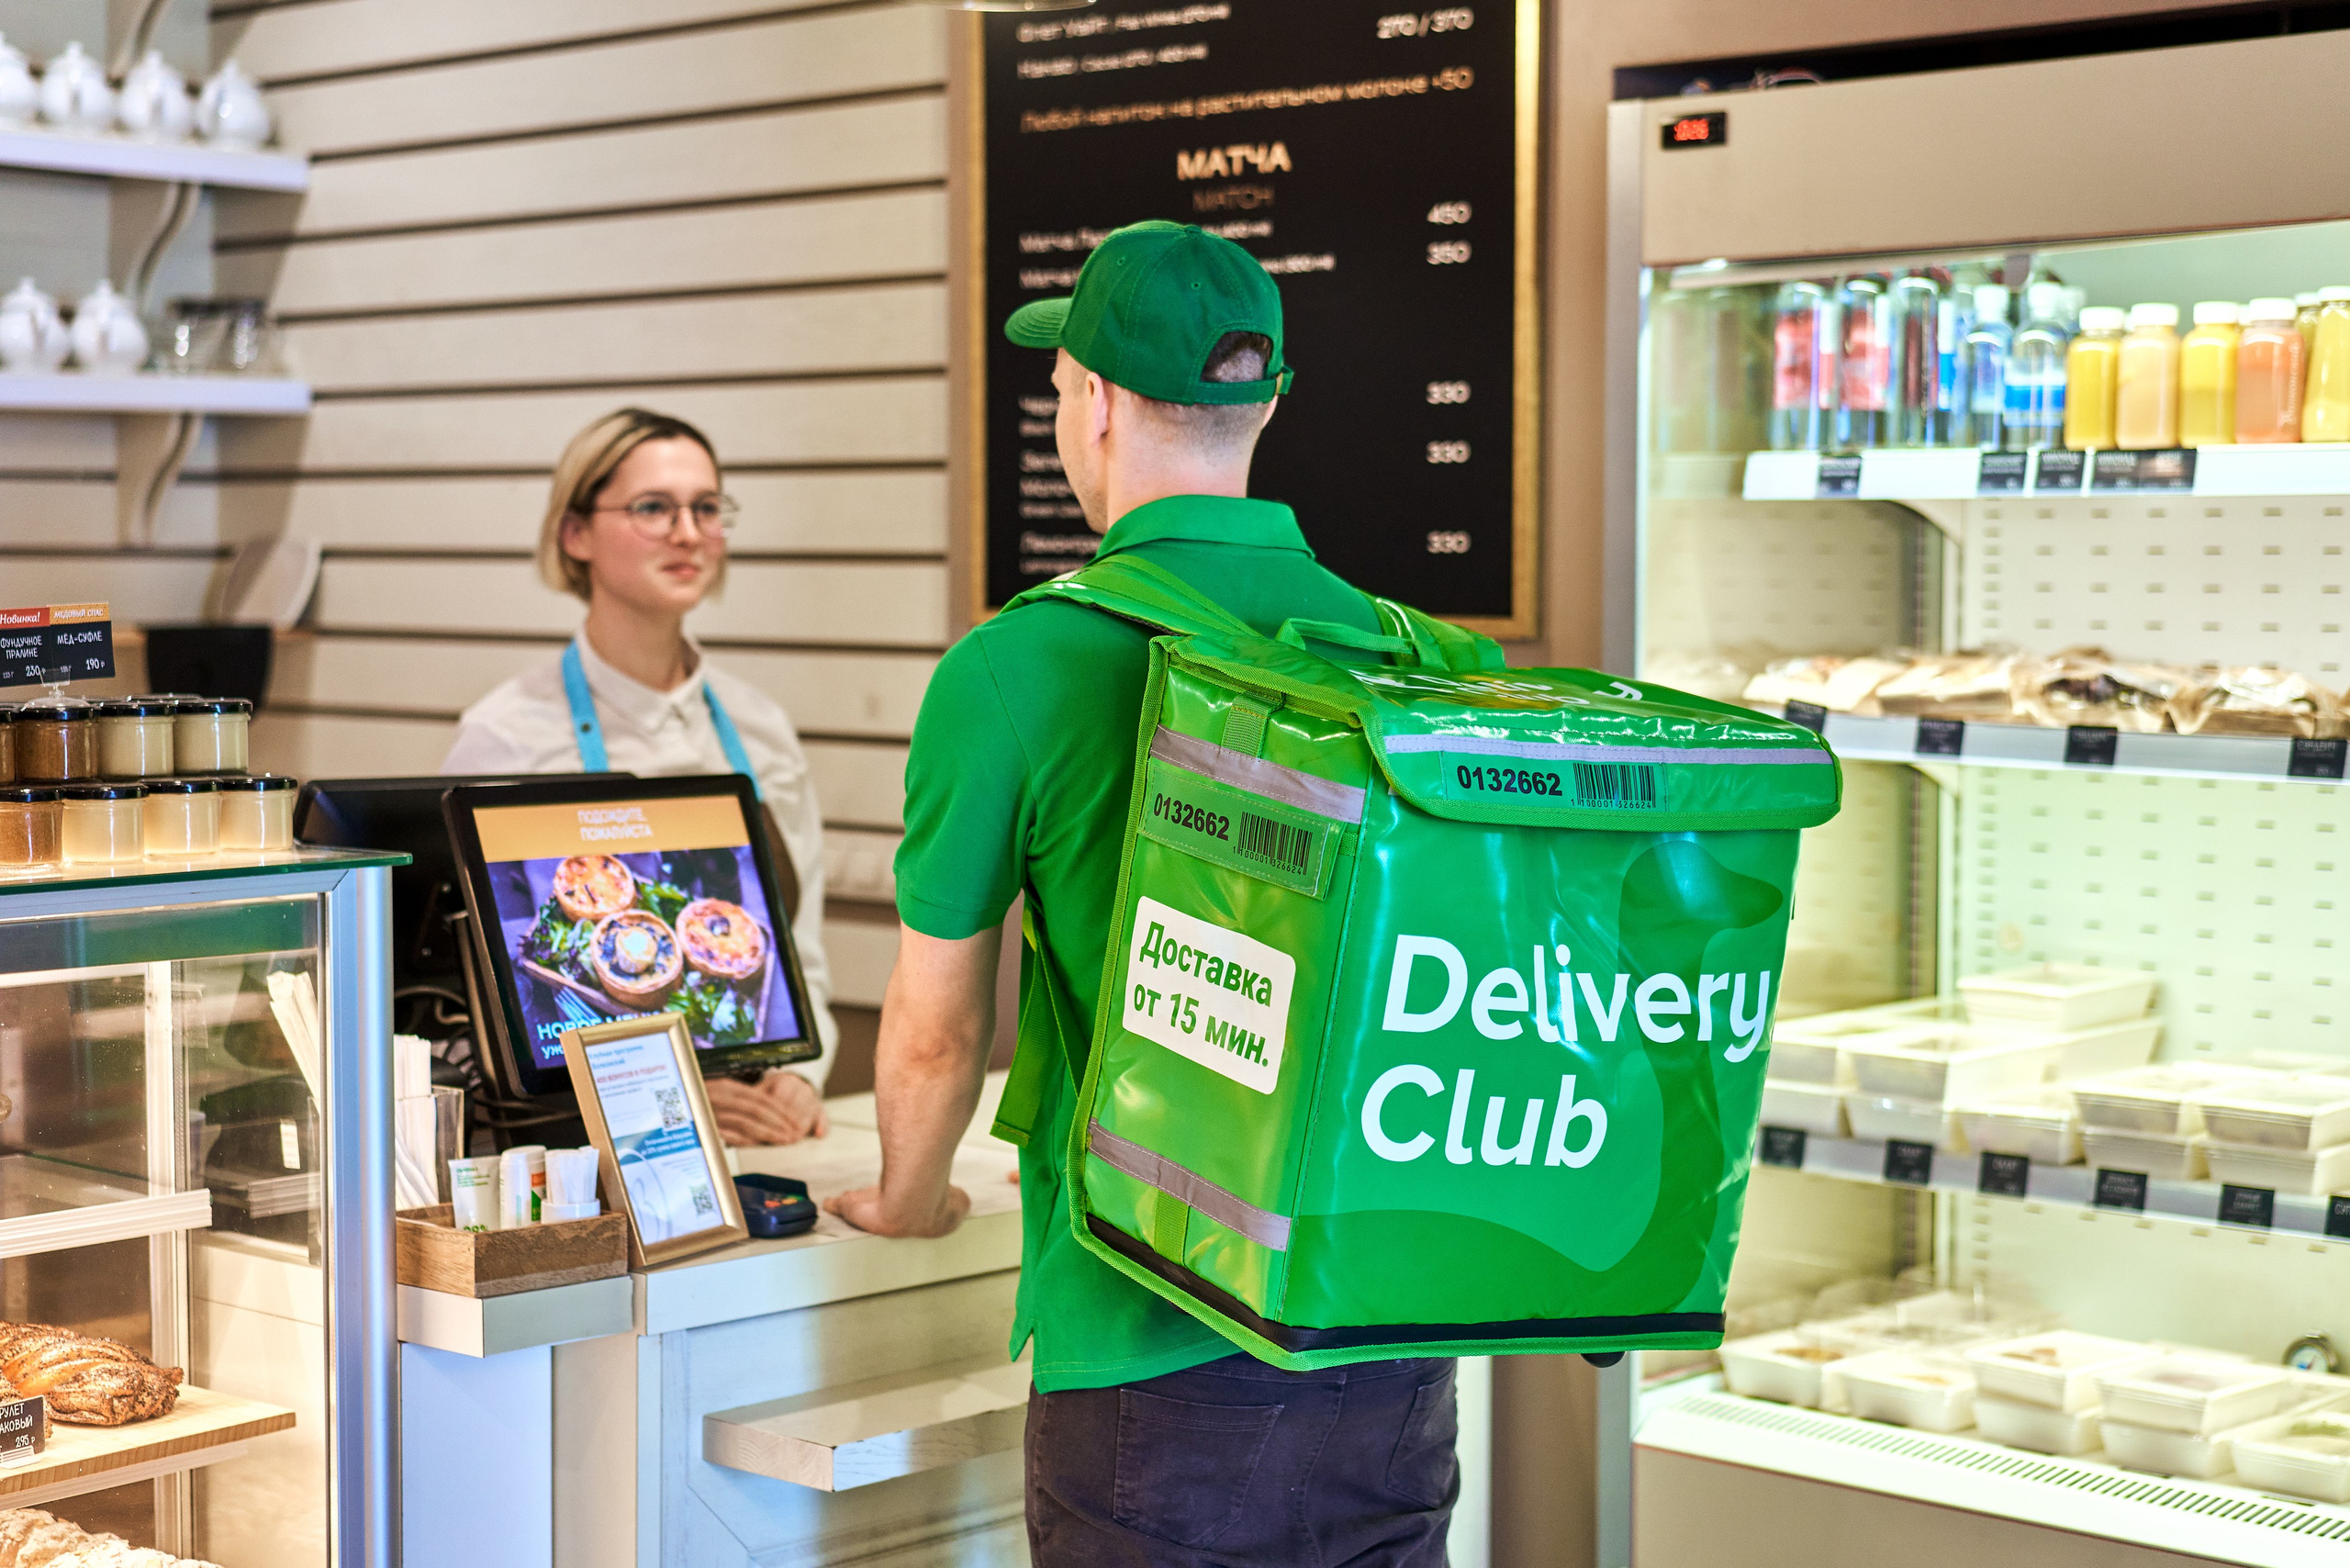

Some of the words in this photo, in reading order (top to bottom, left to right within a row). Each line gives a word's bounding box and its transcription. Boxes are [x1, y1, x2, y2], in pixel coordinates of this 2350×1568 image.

[1176, 140, 1292, 181] МАТЧА
[0, 611, 40, 624] Новинка!
[0, 635, 42, 649] ФУНДУЧНОЕ
[6, 647, 39, 660] ПРАЛИНЕ
[26, 665, 40, 678] 230
[86, 658, 100, 670] 190
[1457, 765, 1563, 797] 0132662
[1154, 793, 1230, 841] 0132662
[1139, 921, 1272, 1007] Доставка
[1382, 934, 1770, 1063] Delivery
[1134, 984, 1161, 1017] от
[1170, 993, 1199, 1035] 15
[1204, 1015, 1269, 1068] мин.
[1360, 1064, 1608, 1168] Club
[0, 1403, 25, 1419] РУЛЕТ
[0, 1415, 33, 1434] АКОВЫЙ
[16, 1435, 29, 1448] 295
